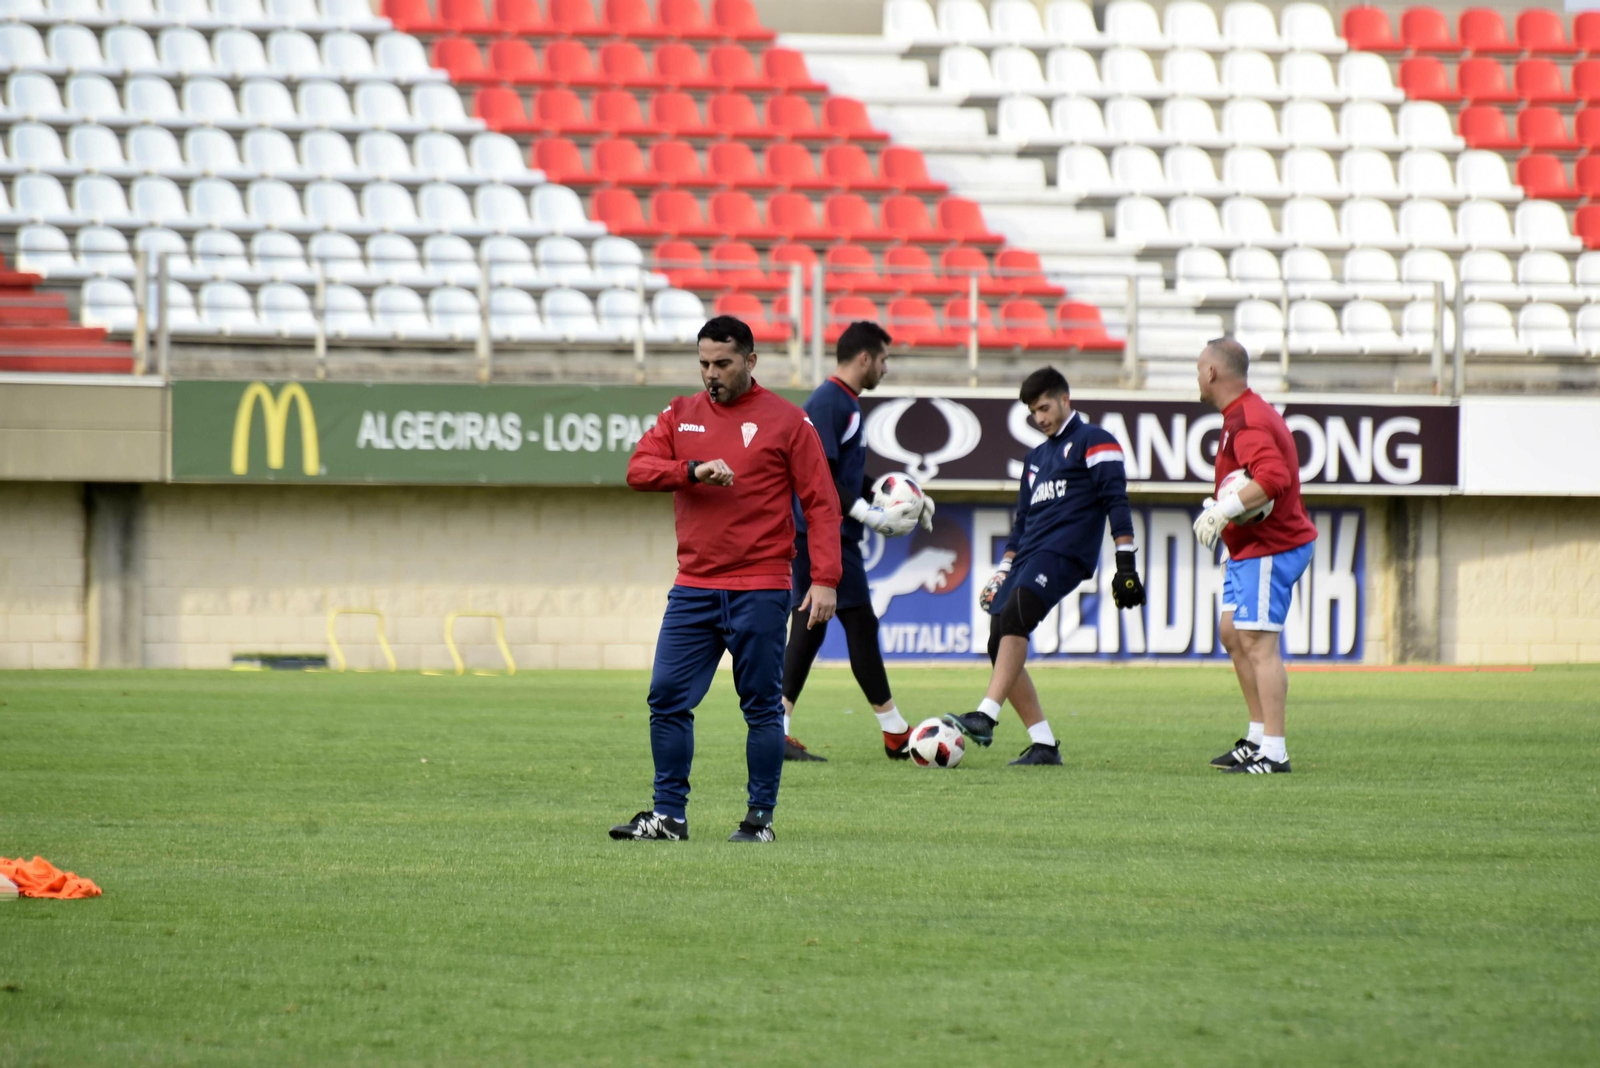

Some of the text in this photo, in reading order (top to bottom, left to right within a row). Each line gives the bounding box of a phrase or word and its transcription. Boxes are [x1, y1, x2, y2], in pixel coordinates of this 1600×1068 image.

[356, 410, 523, 451] ALGECIRAS
[543, 412, 603, 452] LOS
[1007, 400, 1422, 484] SANGONG
[881, 623, 970, 653] VITALIS
